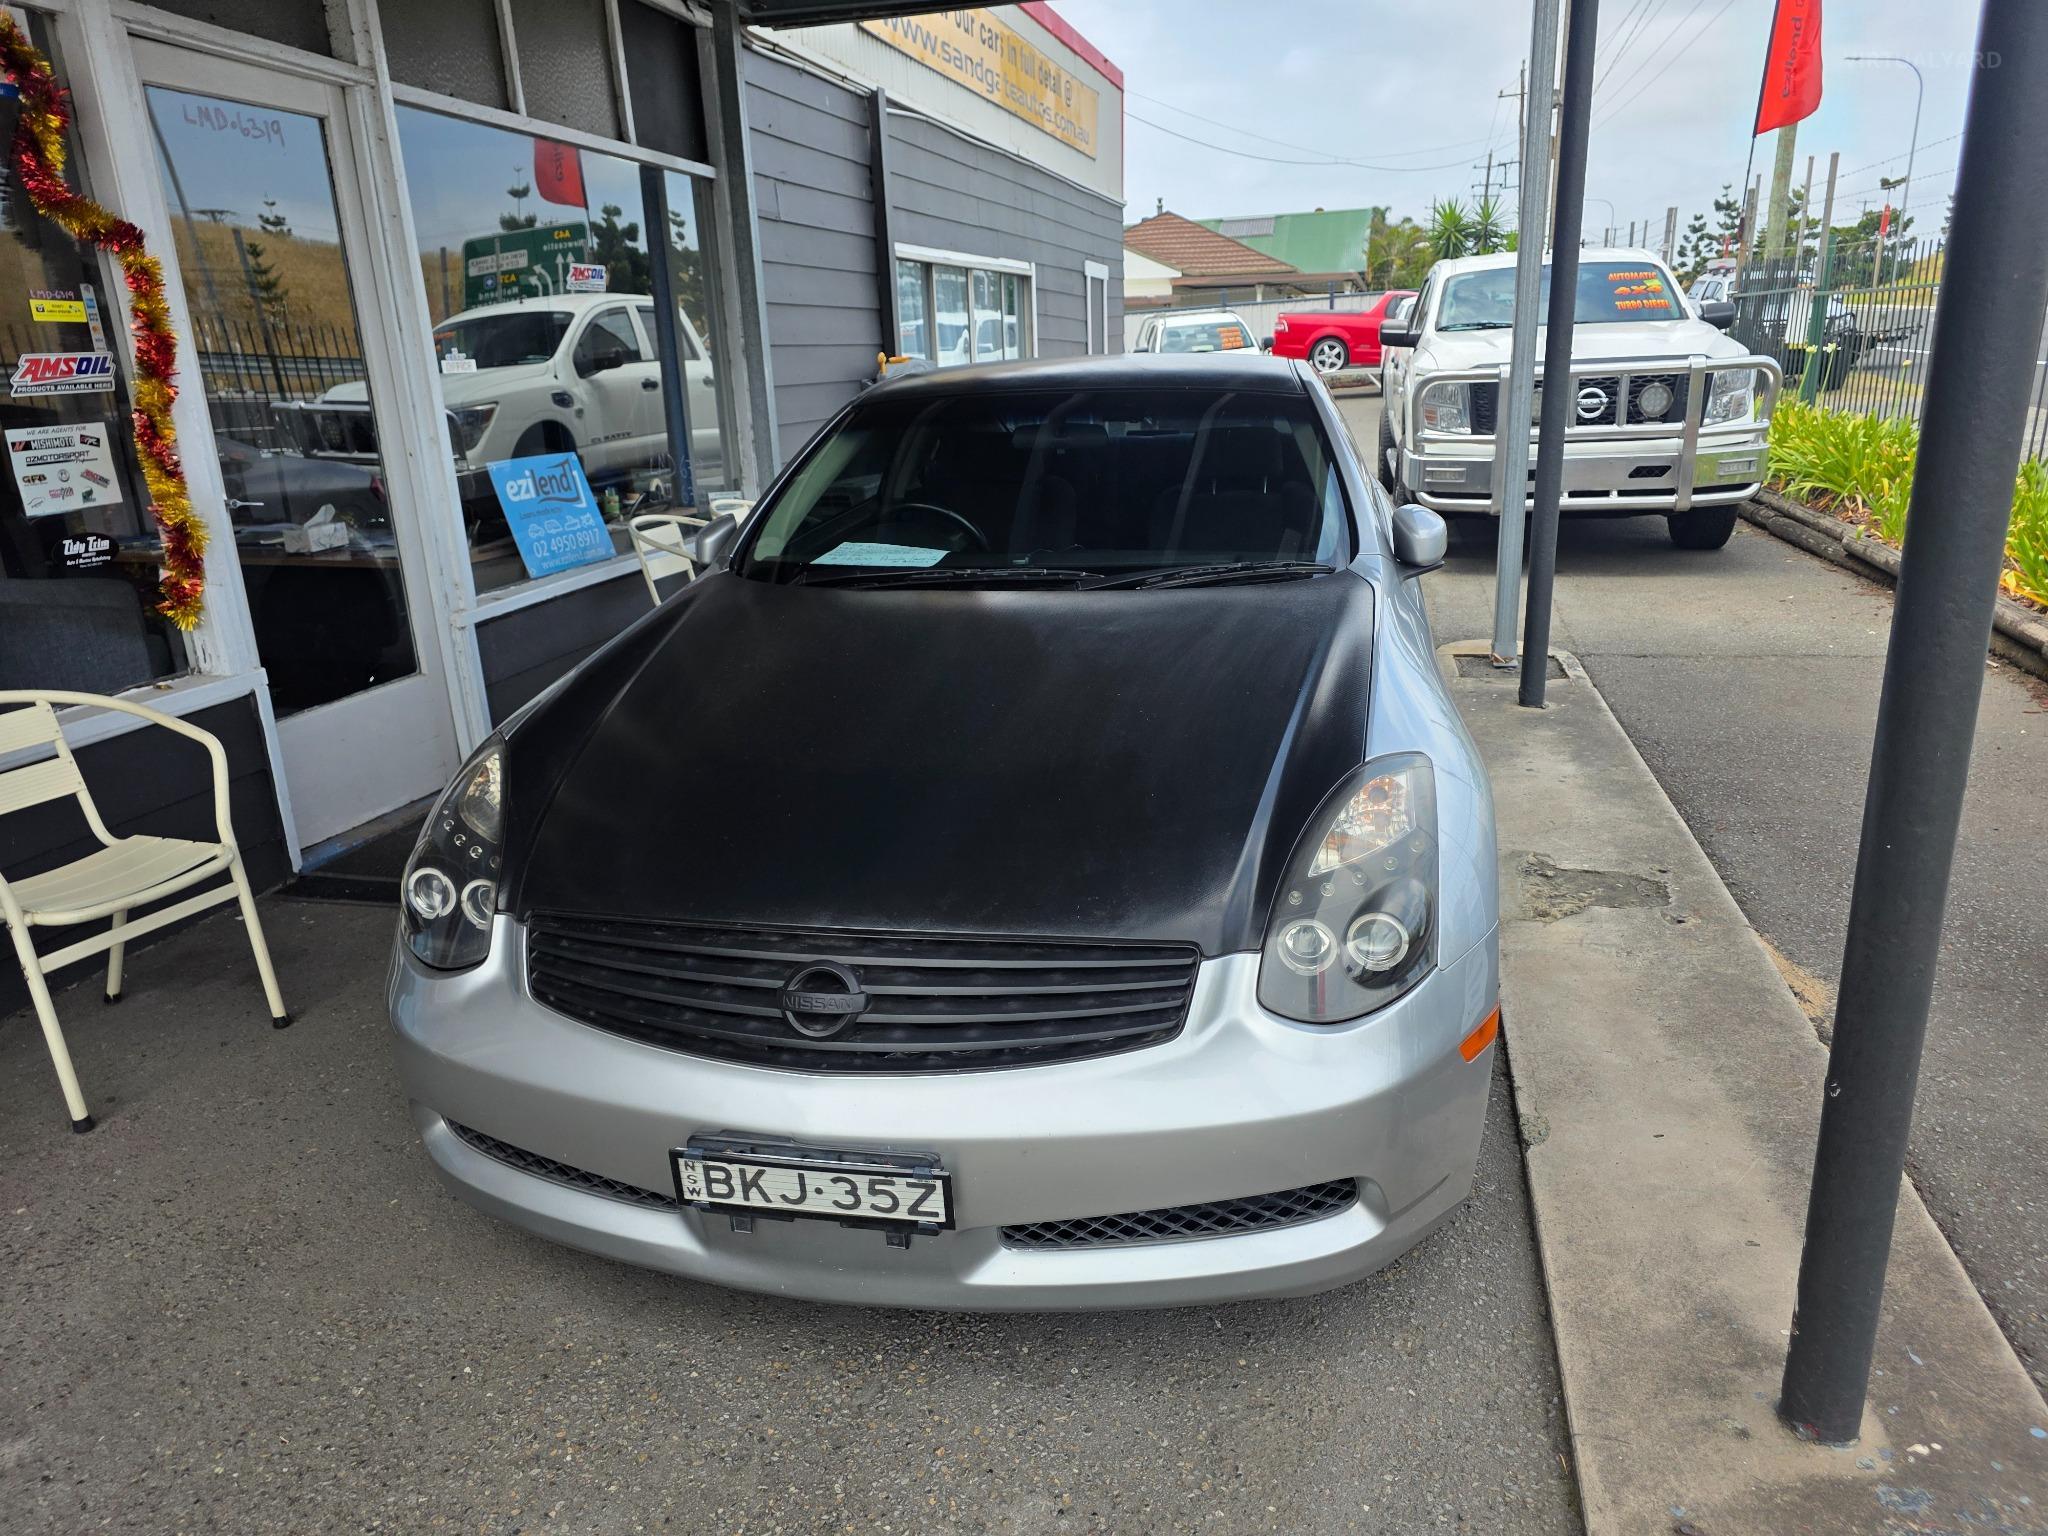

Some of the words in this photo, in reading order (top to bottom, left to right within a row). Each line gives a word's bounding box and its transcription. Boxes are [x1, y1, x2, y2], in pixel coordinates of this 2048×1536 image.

[570, 266, 604, 281] AMSOIL
[1608, 272, 1657, 281] AUTOMATIC
[1615, 300, 1643, 310] TURBO
[1643, 299, 1672, 309] DIESEL
[19, 356, 112, 383] AMSOIL
[17, 384, 55, 393] PRODUCTS
[57, 382, 92, 391] AVAILABLE
[30, 436, 76, 450] MISHIMOTO
[506, 462, 574, 502] ezilend
[63, 539, 86, 556] Tidy
[87, 536, 110, 552] Trim
[533, 540, 549, 557] 02
[551, 532, 577, 554] 4950
[578, 528, 600, 548] 8917
[783, 995, 853, 1011] NISSAN
